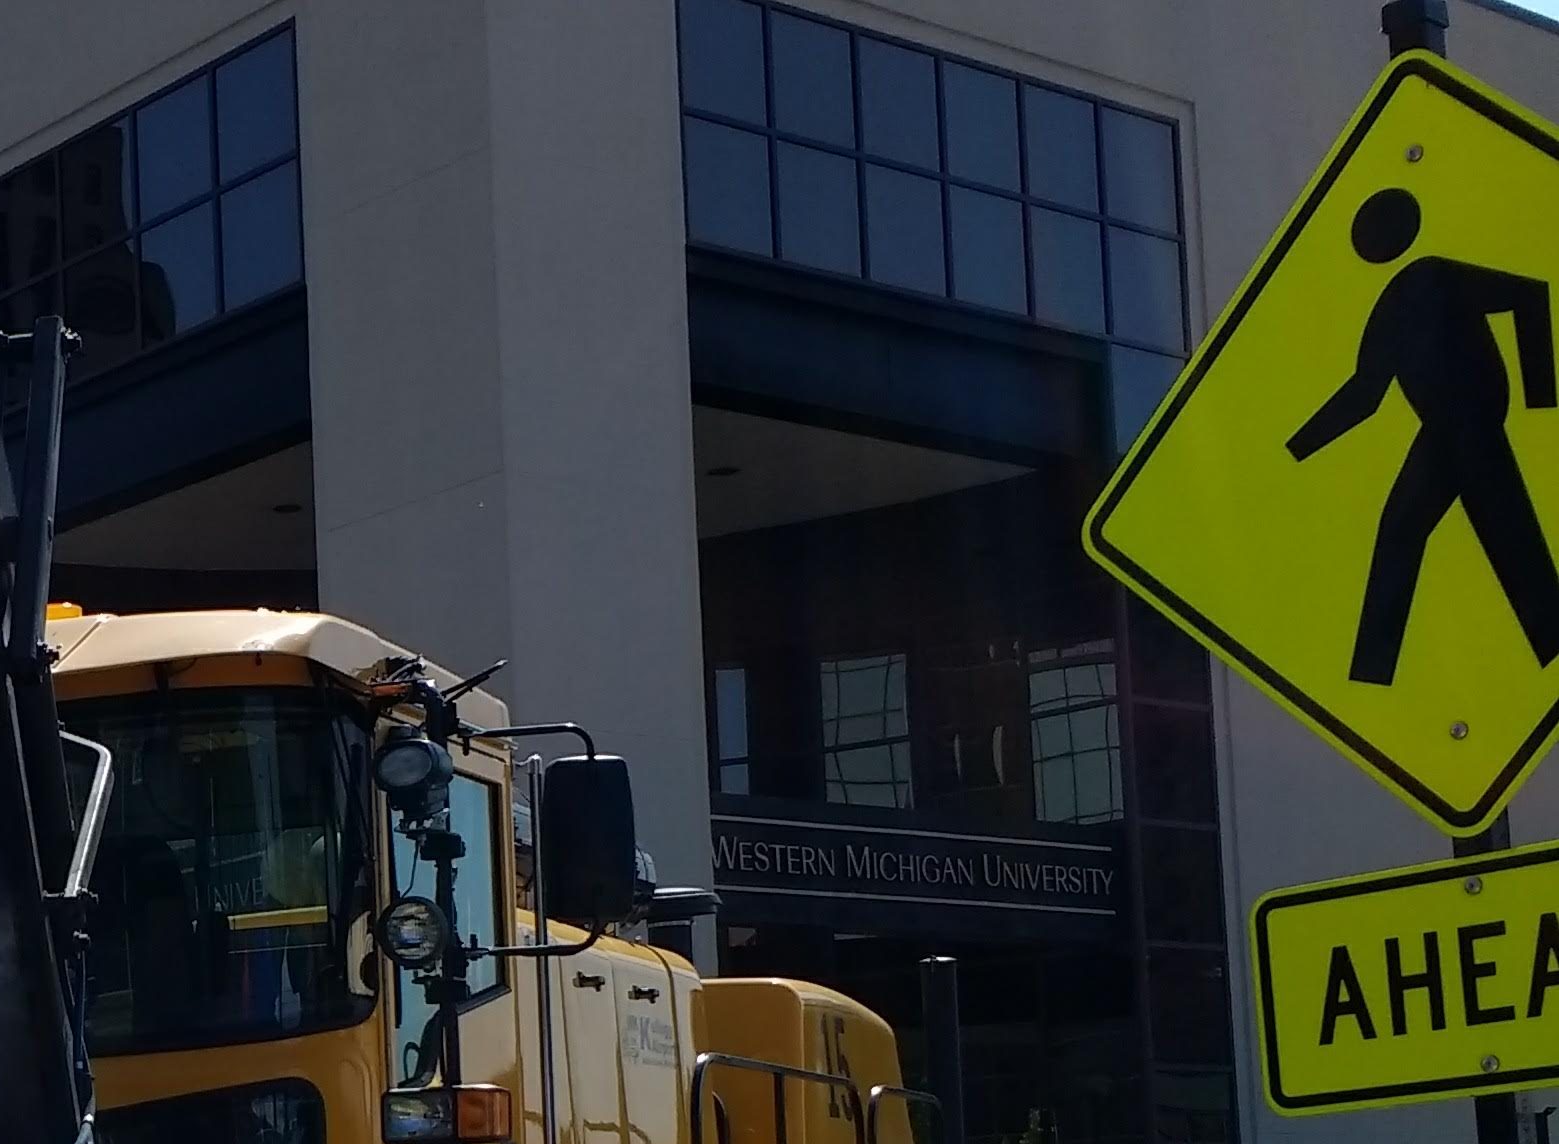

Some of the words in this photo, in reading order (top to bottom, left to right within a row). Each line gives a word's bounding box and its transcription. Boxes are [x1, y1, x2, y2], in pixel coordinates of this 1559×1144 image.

[710, 835, 836, 876] WESTERN
[846, 844, 975, 886] MICHIGAN
[983, 853, 1115, 895] UNIVERSITY
[1319, 912, 1559, 1046] AHEA
[820, 1013, 853, 1122] 15
